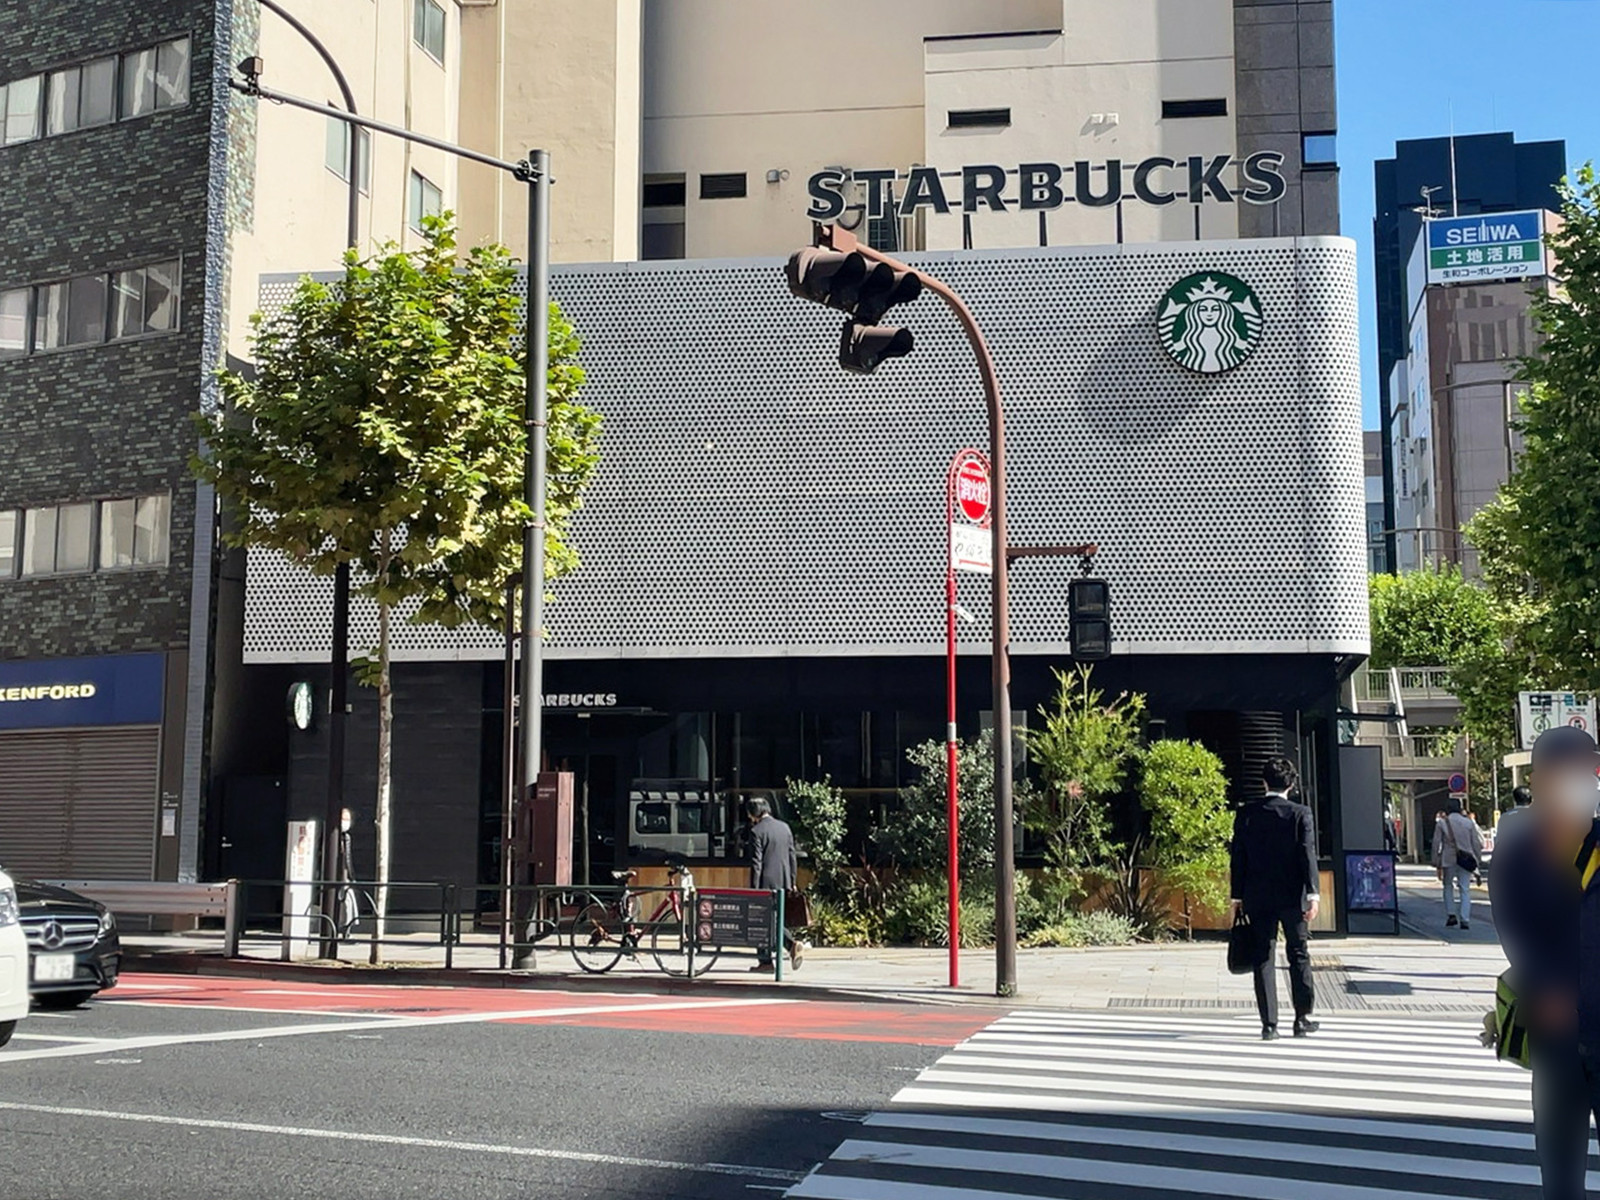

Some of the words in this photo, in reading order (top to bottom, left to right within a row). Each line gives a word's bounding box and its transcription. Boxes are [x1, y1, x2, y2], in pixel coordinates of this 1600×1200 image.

[806, 151, 1287, 221] STARBUCKS
[1446, 219, 1520, 243] SEIWA
[1446, 246, 1523, 265] 土地活用
[1444, 266, 1527, 278] 生和コーポレーション
[511, 694, 616, 707] SARBUCKS
